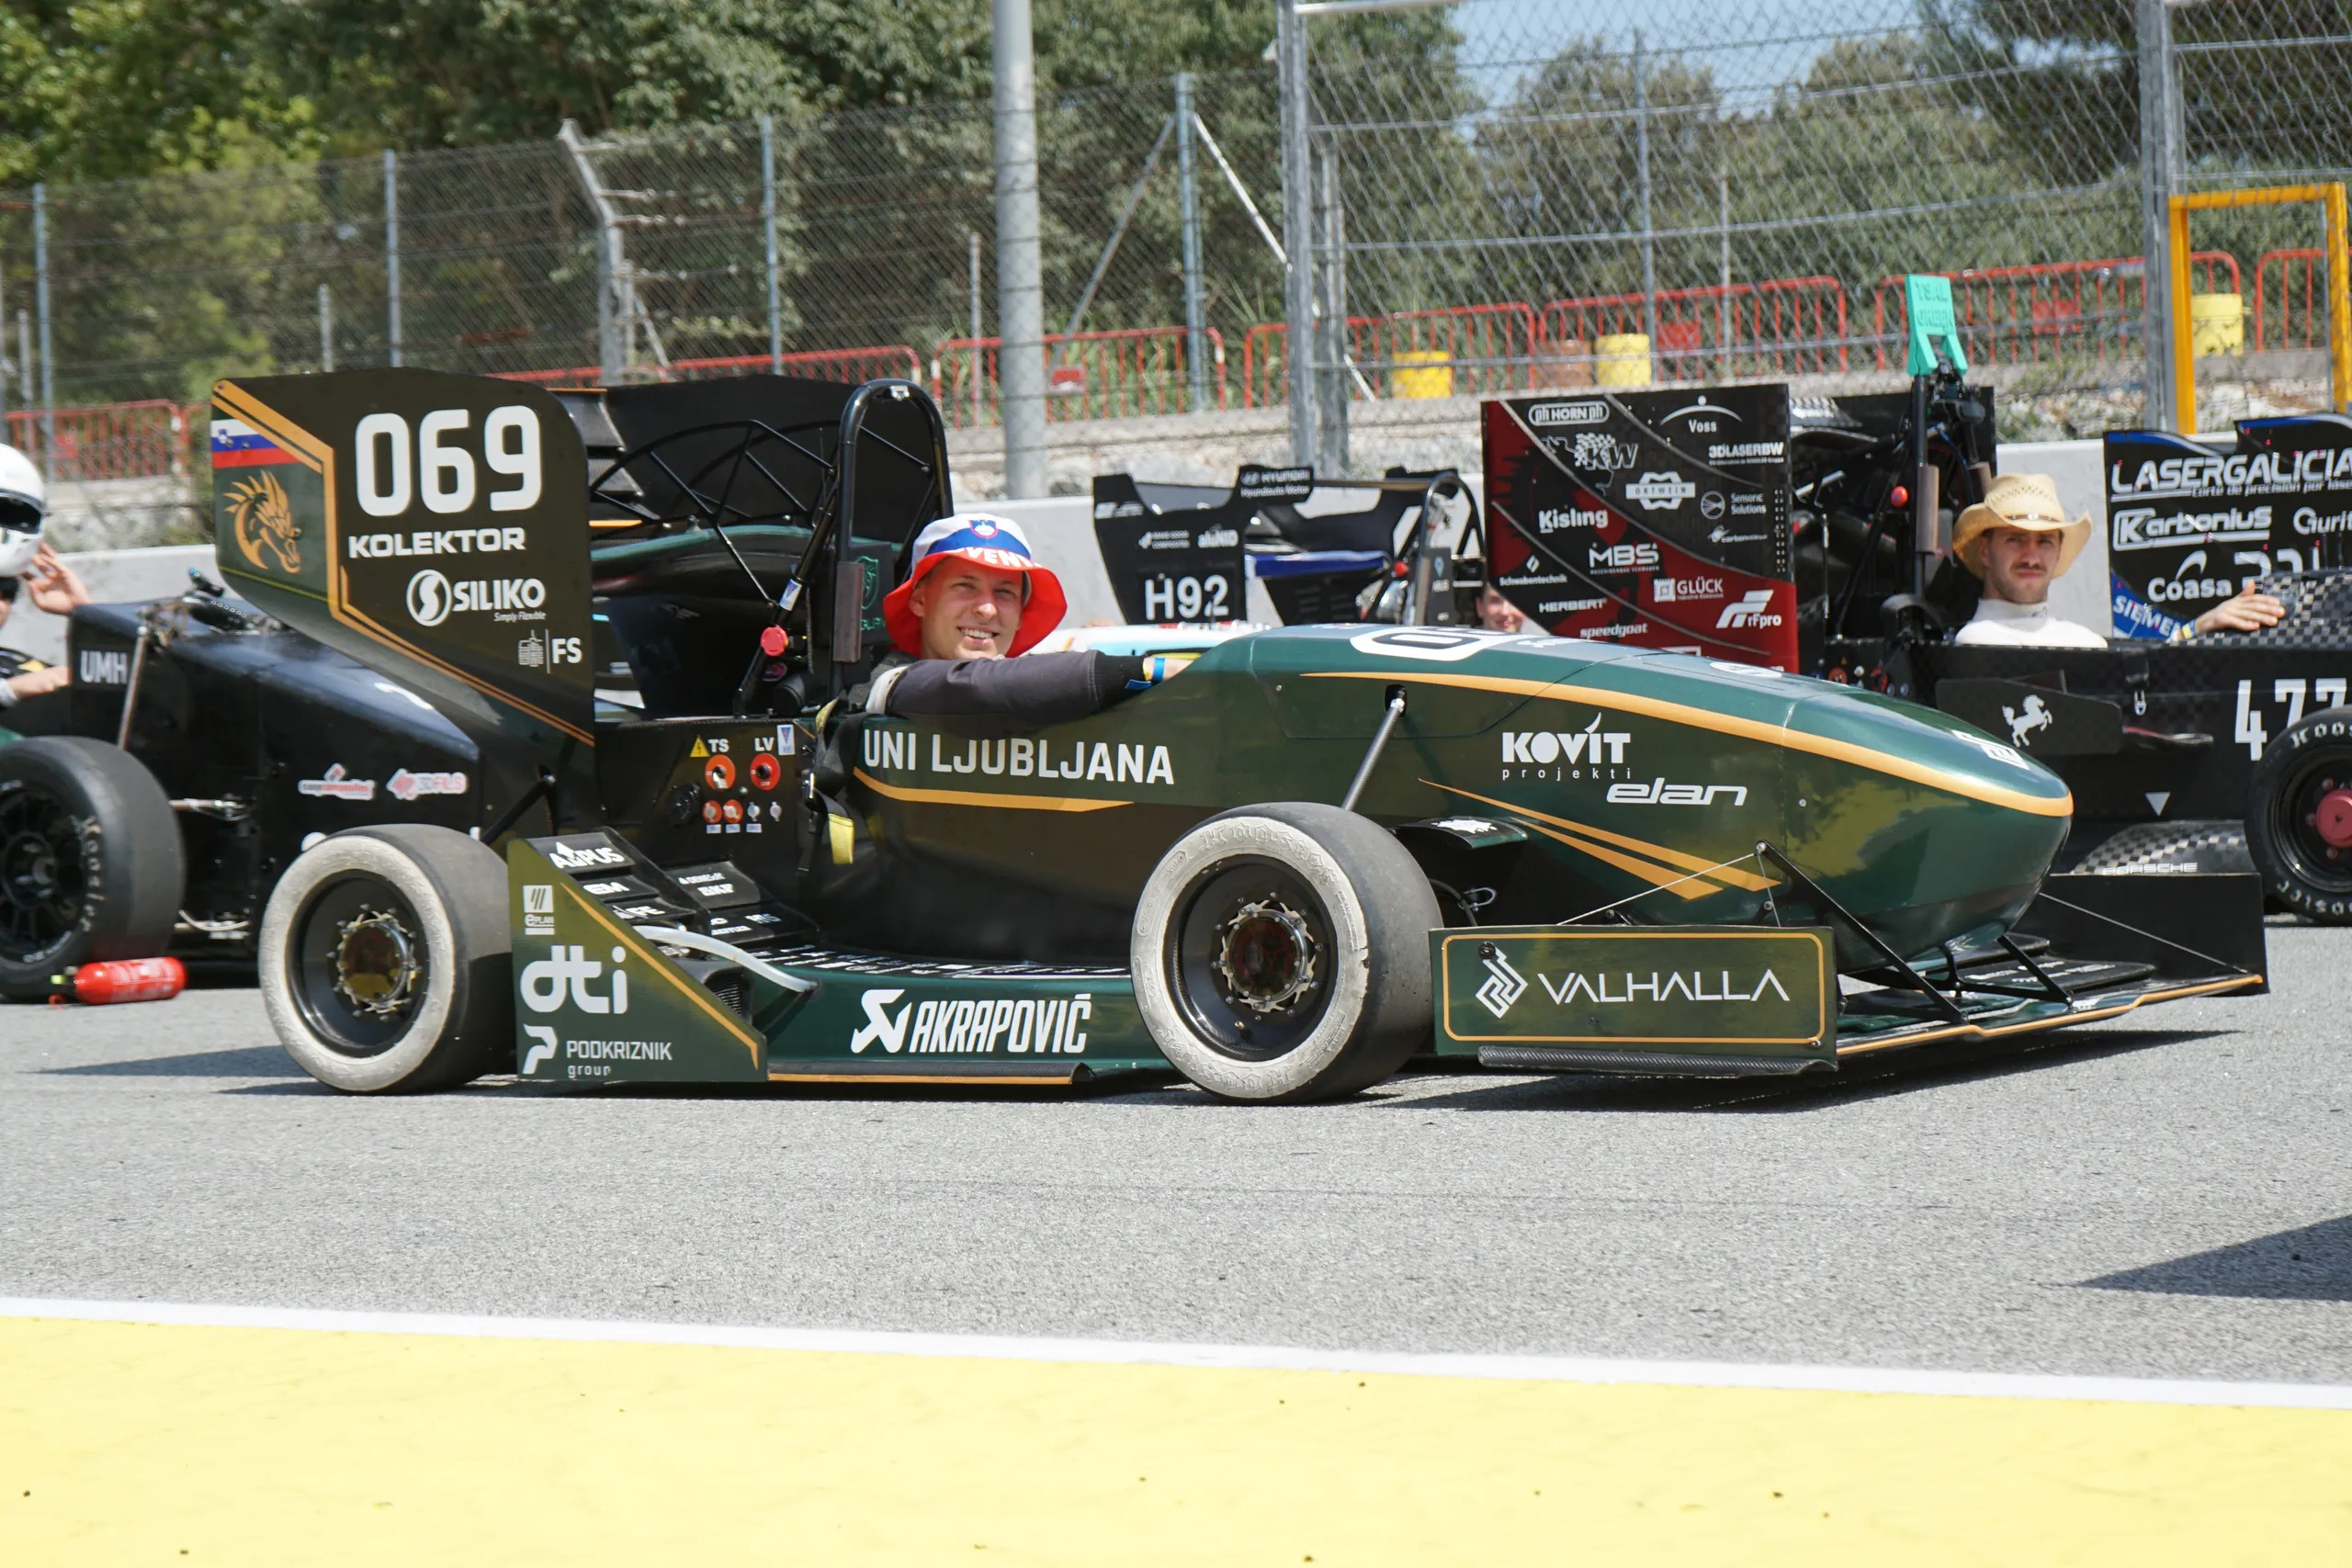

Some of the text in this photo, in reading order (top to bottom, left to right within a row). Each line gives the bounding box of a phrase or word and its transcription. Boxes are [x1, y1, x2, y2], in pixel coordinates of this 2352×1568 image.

[1551, 406, 1589, 422] HORN
[1689, 420, 1717, 433] Voss
[355, 405, 542, 517] 069
[1709, 442, 1784, 458] 3DLASERBW
[2112, 446, 2352, 494] LASERGALICIA
[2227, 485, 2243, 496] de
[2303, 479, 2324, 494] por
[1539, 509, 1608, 530] Kisling
[2119, 506, 2273, 544] Karbonius
[348, 527, 526, 558] KOLEKTOR
[1589, 543, 1659, 568] MBS
[1499, 574, 1567, 586] Schwabentechnik
[1677, 576, 1724, 594] GLÜCK
[2147, 578, 2232, 602] Coasa
[452, 578, 547, 612] SILIKO
[1144, 575, 1230, 621] H92
[1539, 599, 1603, 613] HERBERT
[1580, 623, 1647, 639] speedgoat
[551, 637, 583, 664] FS
[81, 650, 128, 684] UMH
[708, 738, 730, 752] TS
[754, 738, 775, 751] LV
[864, 728, 917, 771] UNI
[932, 734, 1175, 784] LJUBLJANA
[1607, 778, 1747, 806] elan
[2102, 863, 2199, 875] PORSCHE
[520, 945, 628, 1014] dti
[1537, 969, 1791, 1005] VALHALLA
[566, 1041, 673, 1061] PODKRIZNIK
[567, 1064, 611, 1078] group
